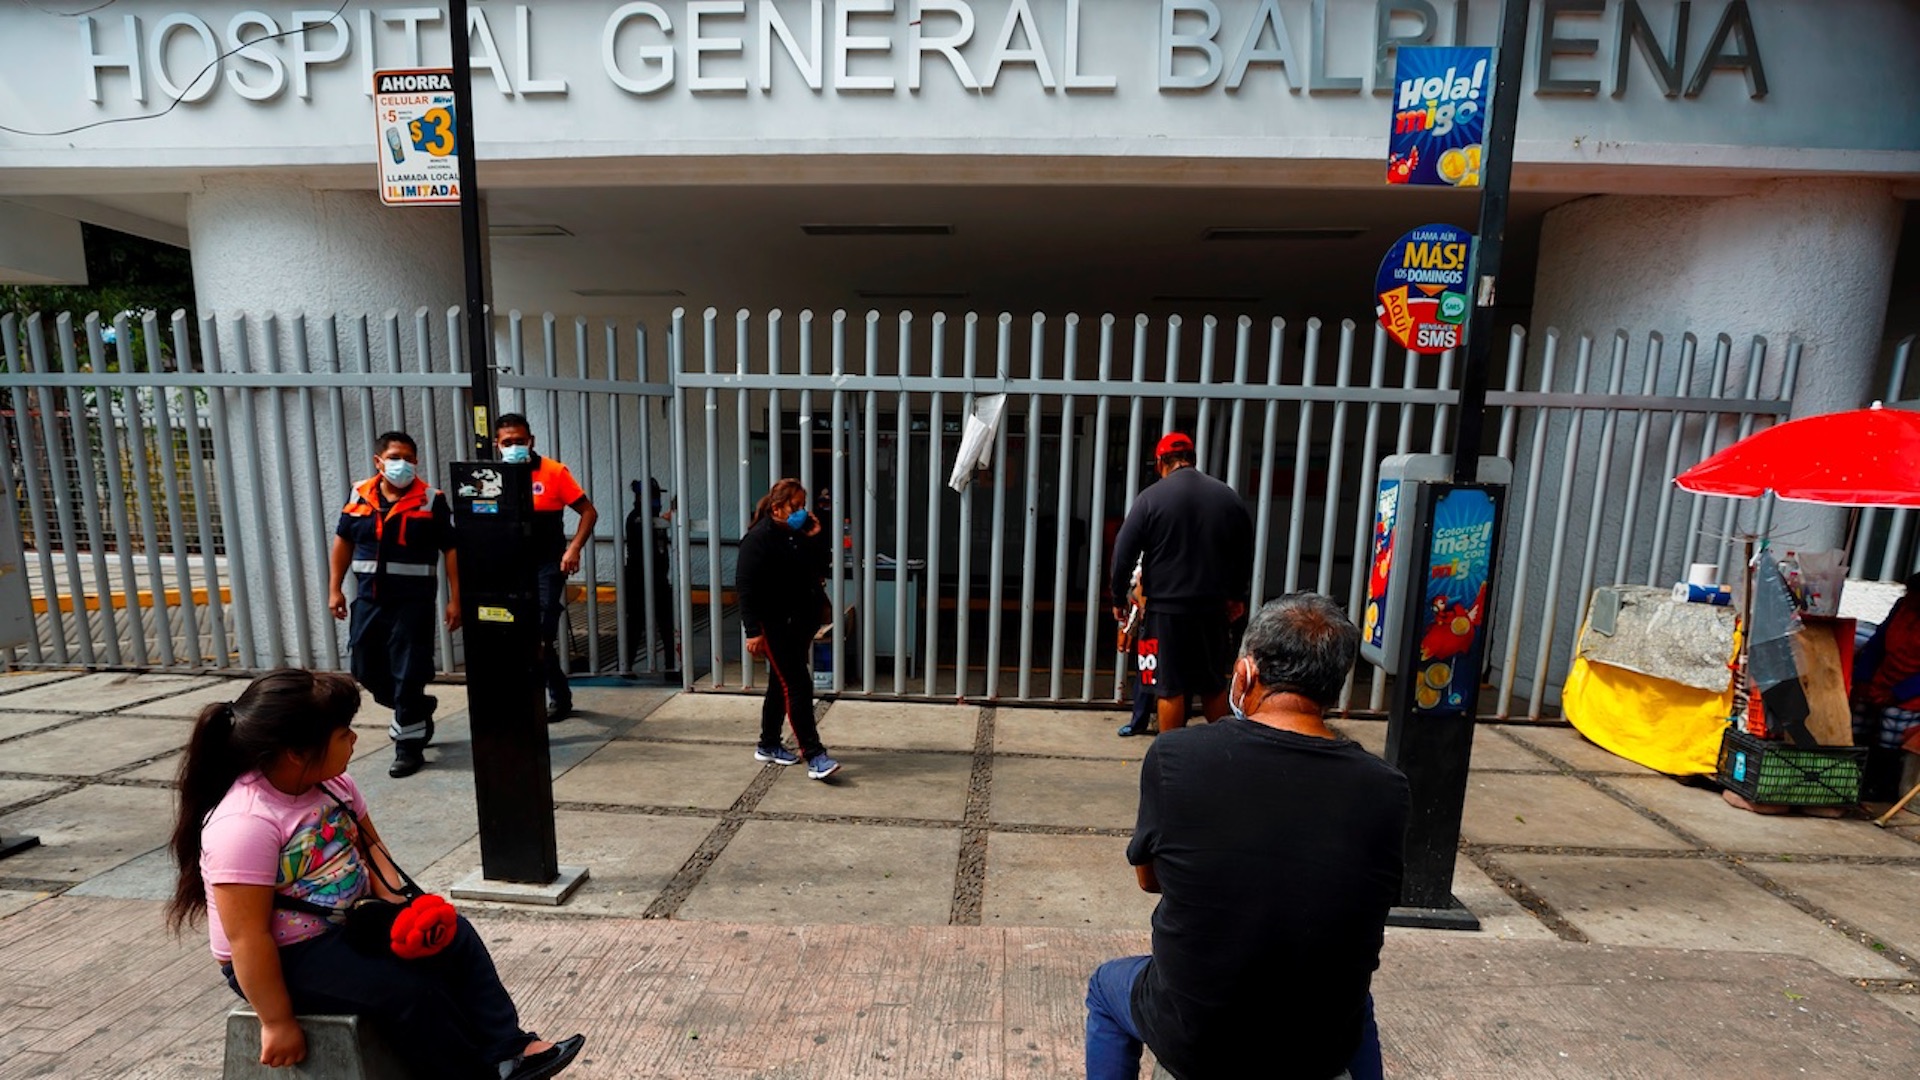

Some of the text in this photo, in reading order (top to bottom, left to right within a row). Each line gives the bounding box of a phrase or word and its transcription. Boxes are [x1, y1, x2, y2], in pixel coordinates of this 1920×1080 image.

[79, 5, 569, 104] HOSPITAL
[601, 0, 1117, 95] GENERAL
[381, 75, 452, 91] AHORRA
[1398, 59, 1487, 109] Hola!
[381, 96, 429, 106] CELULAR
[1395, 100, 1478, 137] migo
[386, 174, 429, 182] LLAMADA
[388, 185, 459, 197] ILIMITADA
[1411, 231, 1438, 241] LLAMA
[1402, 241, 1467, 270] MÁS!
[1393, 268, 1463, 284] LOS DOMINGOS
[1416, 330, 1457, 348] SMS
[1463, 549, 1486, 559] con
